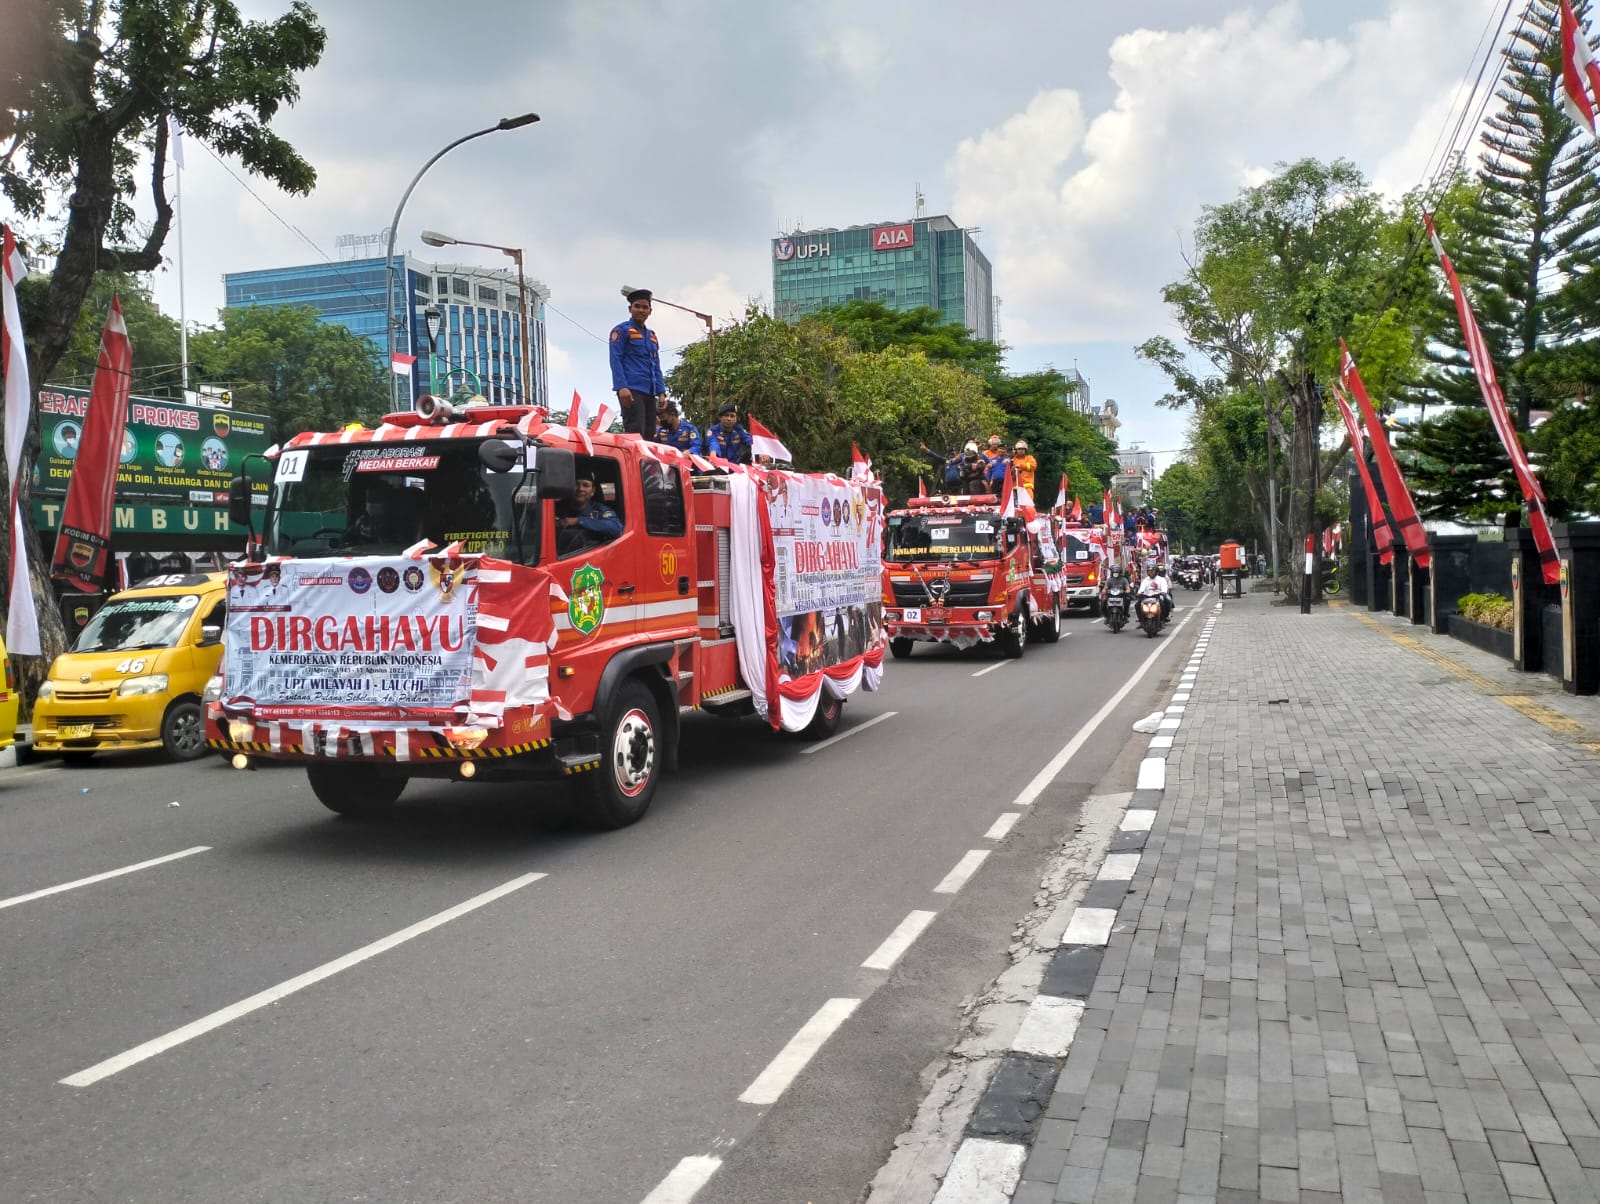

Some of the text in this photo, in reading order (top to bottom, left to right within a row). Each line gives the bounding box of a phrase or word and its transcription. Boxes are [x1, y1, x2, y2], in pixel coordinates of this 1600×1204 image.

[877, 229, 909, 246] AIA
[797, 242, 830, 259] UPH
[132, 404, 200, 430] PROKES
[280, 457, 298, 476] 01
[358, 458, 438, 470] MEDAN BERKAH
[49, 468, 73, 478] DEM
[158, 476, 201, 487] KELUARGA
[204, 480, 221, 488] DAN
[251, 482, 269, 491] LAIN
[64, 527, 90, 541] KODIM
[979, 523, 991, 531] 02
[444, 531, 510, 541] FIREFIGHTER
[468, 541, 487, 553] UPT
[794, 540, 860, 575] DIRGAHAYU
[662, 556, 676, 577] 50
[146, 574, 185, 586] 46
[906, 611, 918, 619] 02
[250, 615, 463, 652] DIRGAHAYU
[115, 658, 147, 674] 46
[269, 655, 442, 666] KEMERDEKAAN REPUBLIK INDONESIA
[285, 678, 305, 690] UPT
[310, 678, 362, 691] WILAYAH
[382, 679, 425, 692] LAUCHI
[278, 691, 311, 702] Pantang
[314, 692, 343, 703] Pulang
[398, 694, 430, 703] Padam
